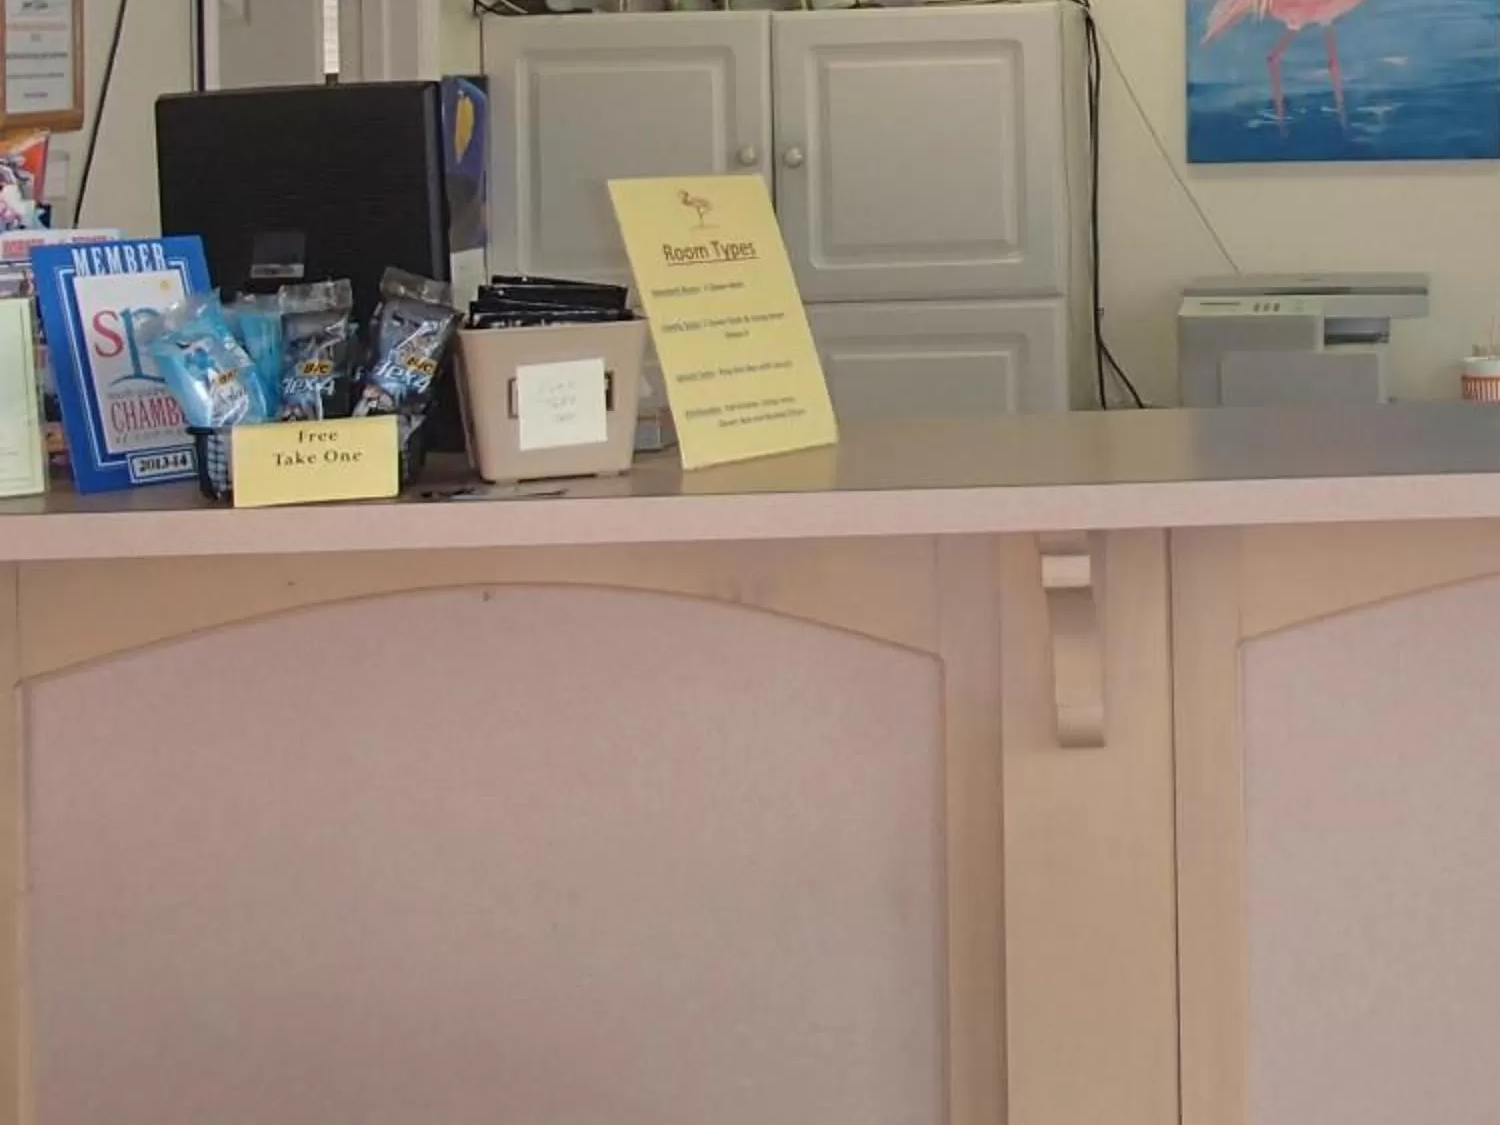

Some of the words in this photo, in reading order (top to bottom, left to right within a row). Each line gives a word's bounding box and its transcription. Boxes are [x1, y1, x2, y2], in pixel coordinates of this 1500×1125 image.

[71, 242, 167, 277] MEMBER
[662, 242, 710, 262] Room
[711, 239, 757, 261] Types
[111, 395, 189, 434] CHAMB
[298, 429, 338, 444] Free
[273, 451, 317, 467] Take
[324, 448, 364, 464] One
